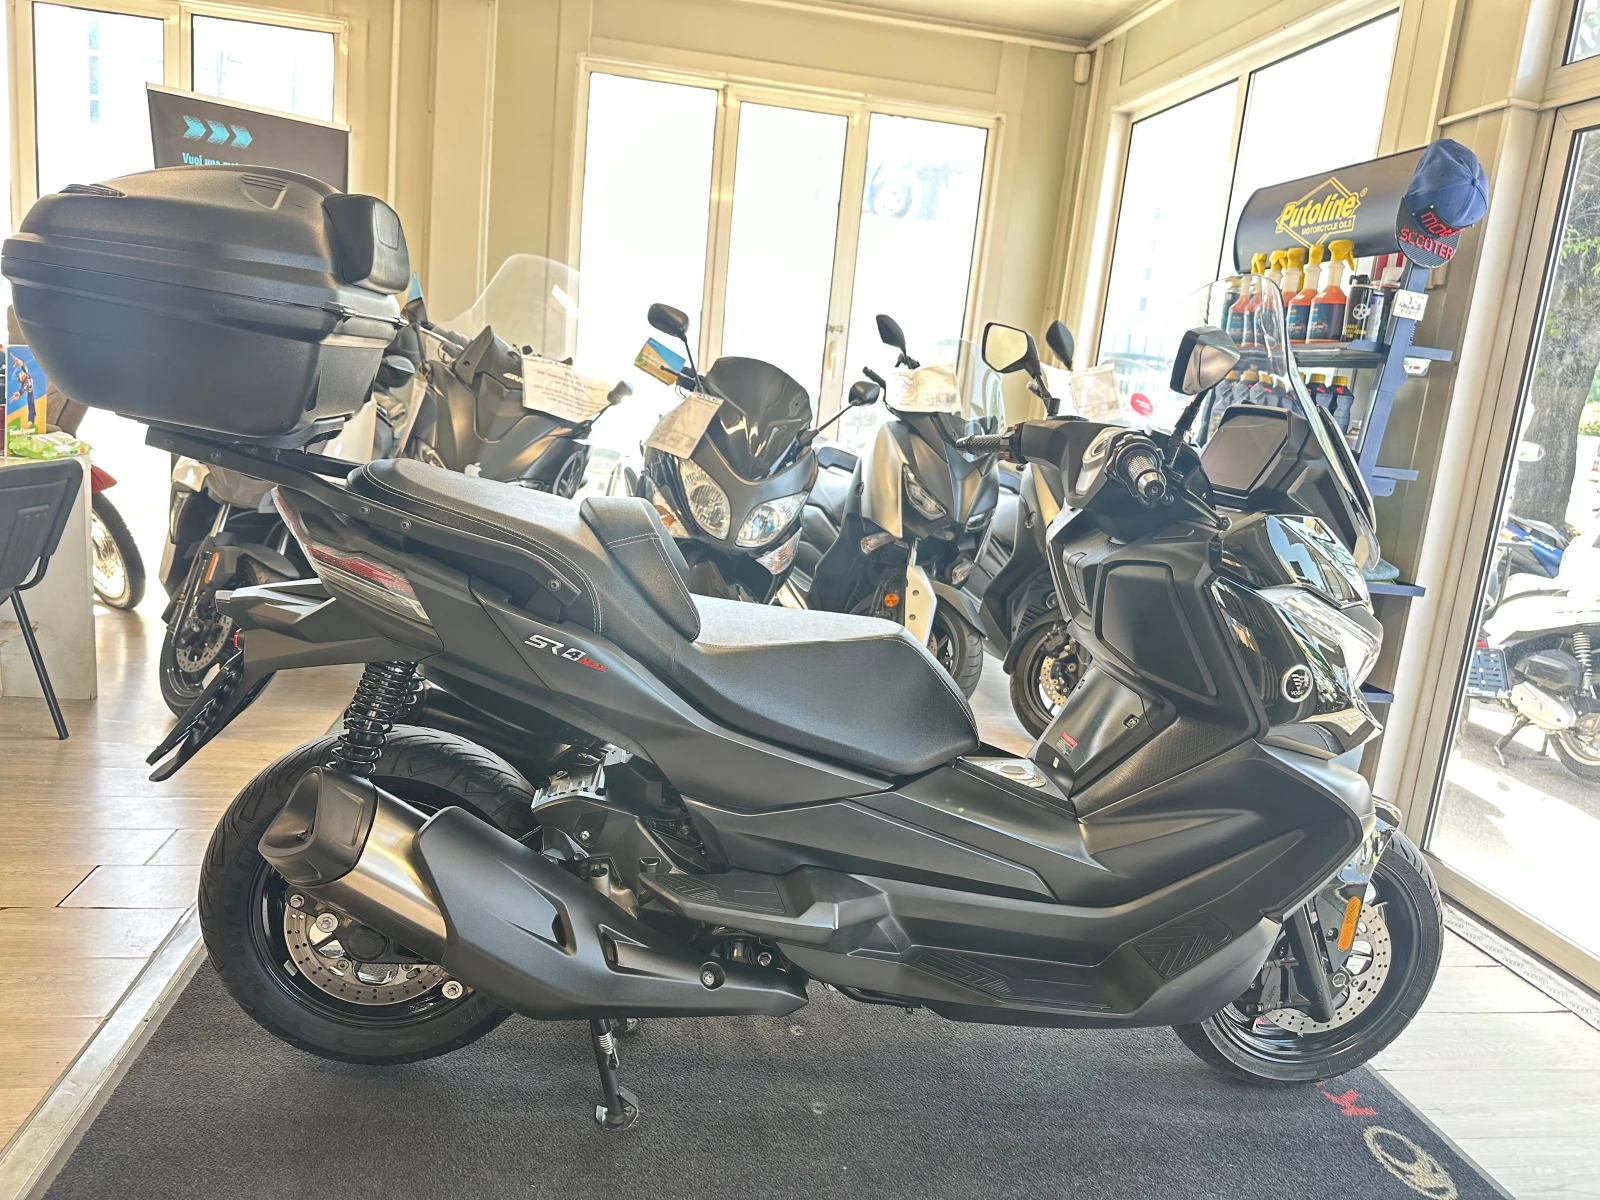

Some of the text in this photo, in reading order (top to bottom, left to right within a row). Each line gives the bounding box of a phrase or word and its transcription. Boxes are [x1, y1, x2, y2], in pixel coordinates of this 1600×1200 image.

[182, 152, 202, 165] Vuoi
[1278, 193, 1357, 230] Putoline
[1301, 220, 1353, 236] MOTORCYCLE OILS
[1399, 227, 1454, 261] SCOOTER
[579, 657, 607, 673] Max
